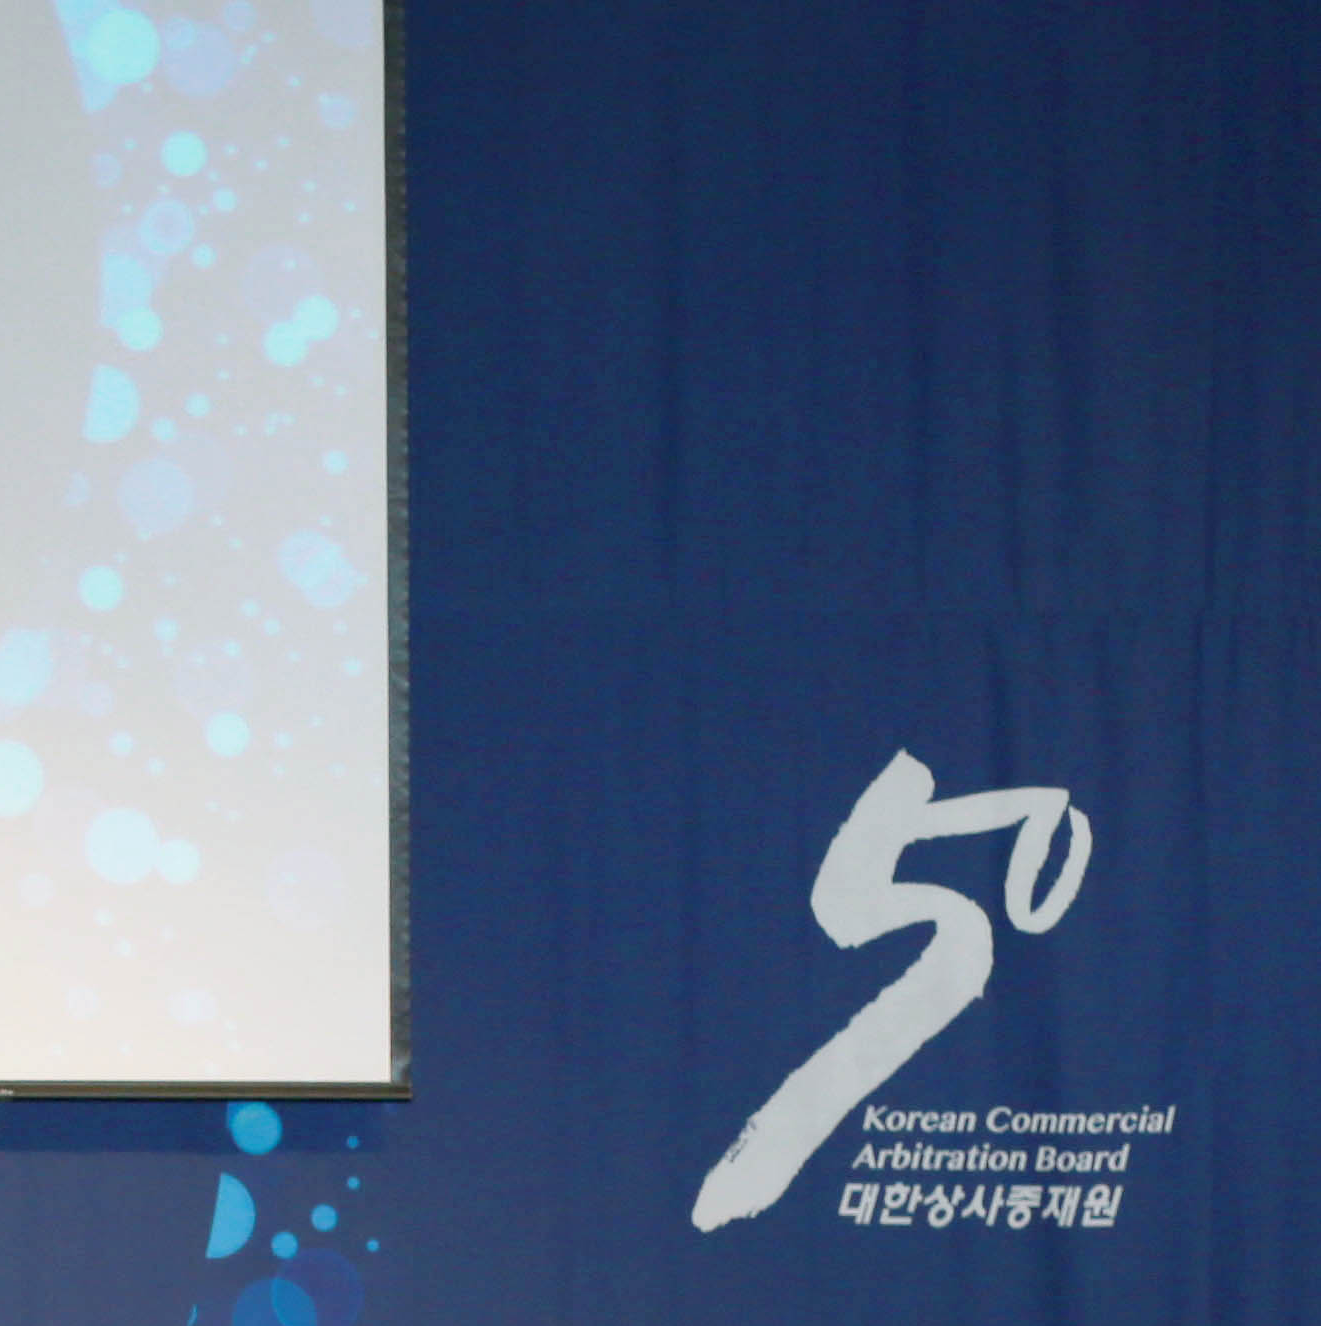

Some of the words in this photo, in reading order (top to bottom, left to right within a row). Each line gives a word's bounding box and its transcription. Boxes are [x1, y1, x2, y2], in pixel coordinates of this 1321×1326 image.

[862, 1105, 978, 1134] Korean
[985, 1104, 1177, 1135] Commercial
[851, 1142, 1028, 1172] Arbitration
[1034, 1142, 1131, 1172] Board
[837, 1181, 1124, 1229] 대한상사중재원
